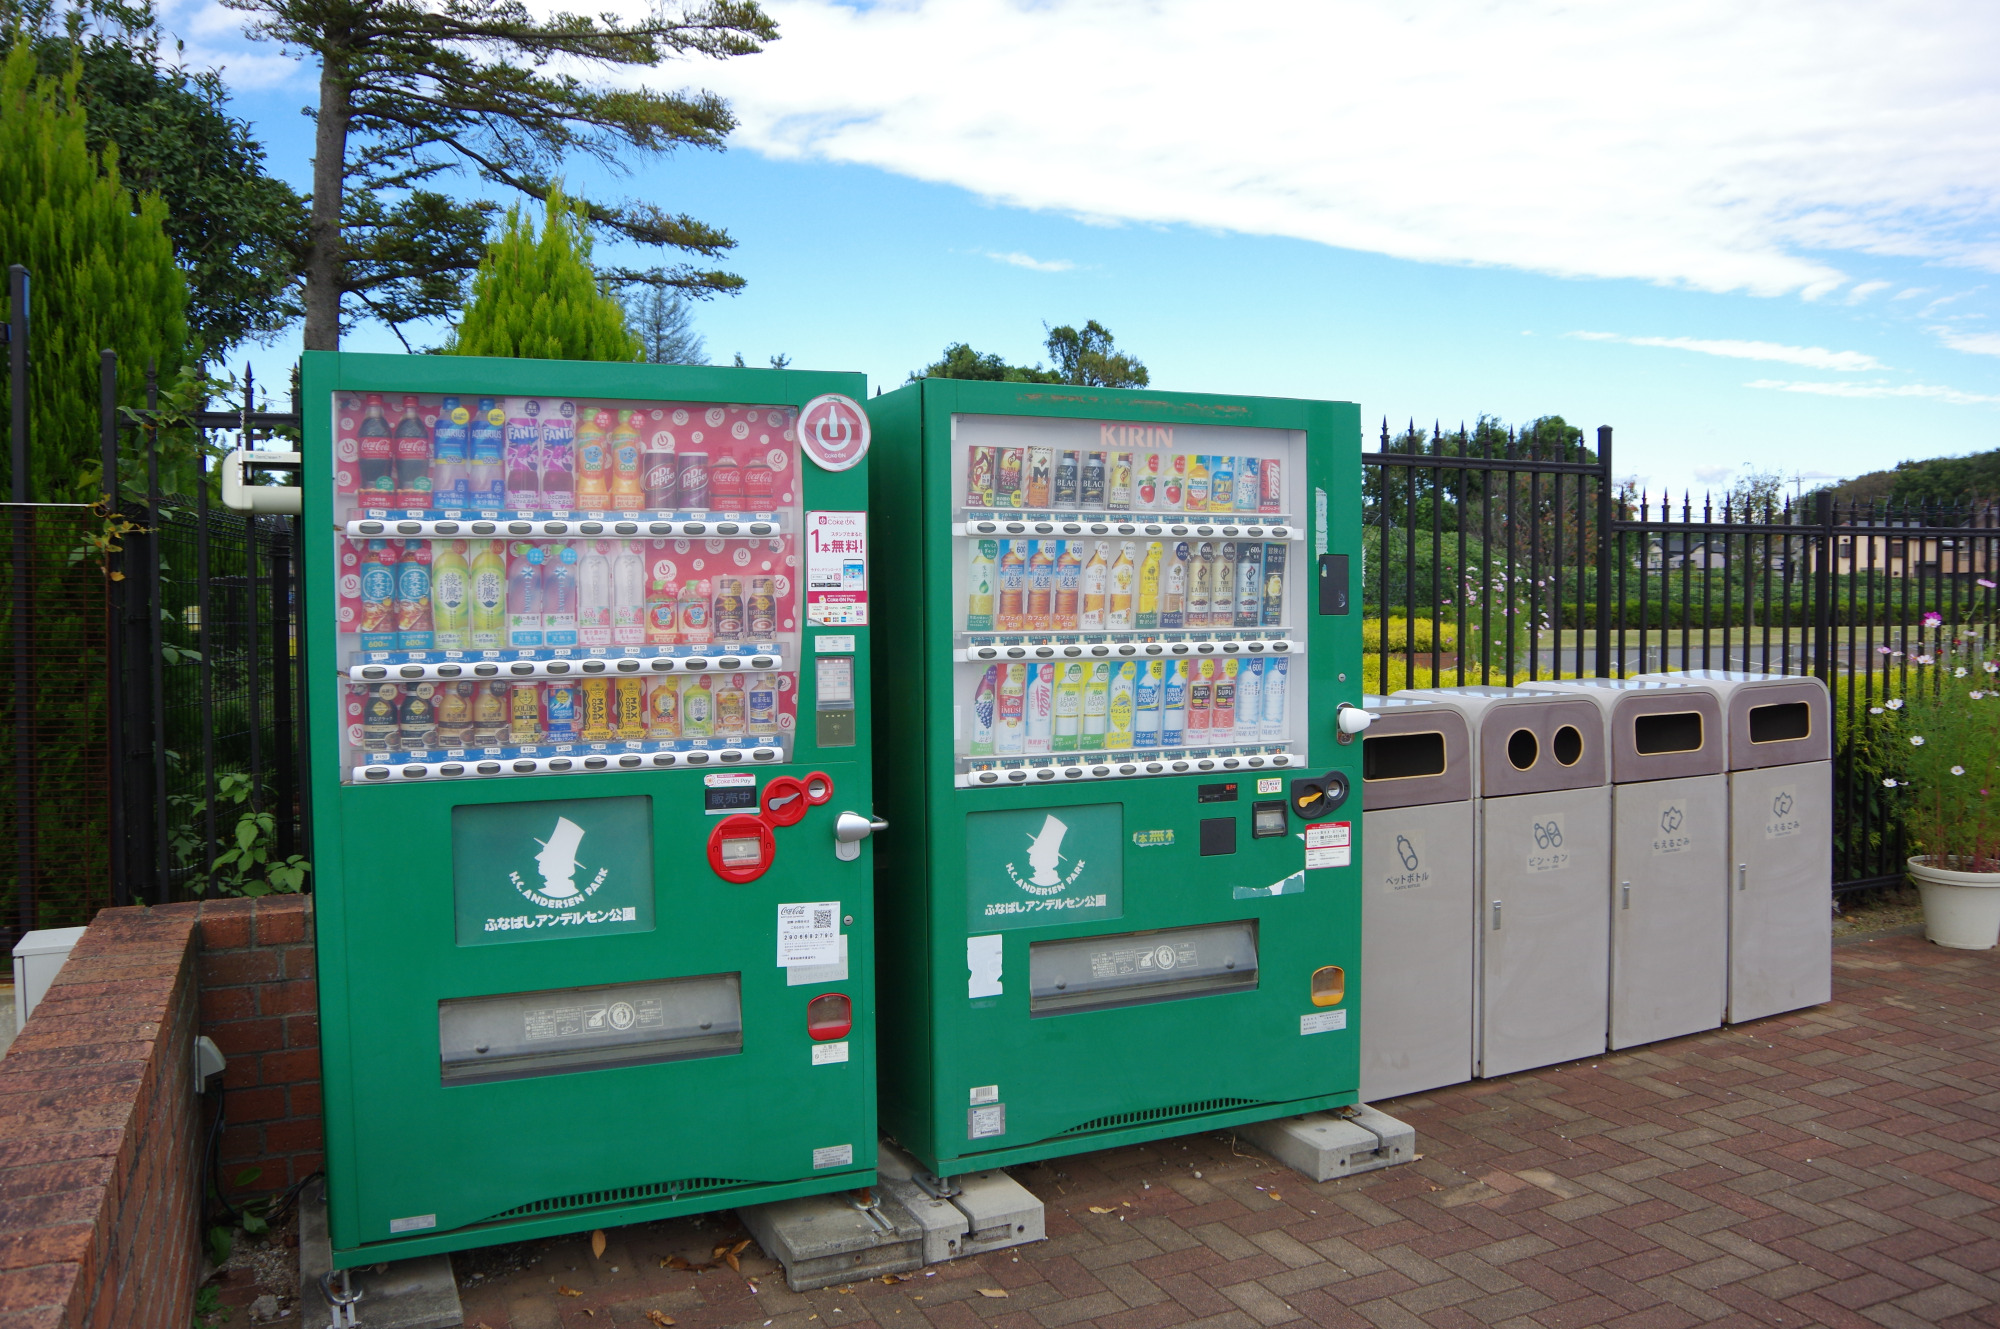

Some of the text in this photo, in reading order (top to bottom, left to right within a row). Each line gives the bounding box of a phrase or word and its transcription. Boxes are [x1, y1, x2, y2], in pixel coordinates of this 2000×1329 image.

[435, 428, 465, 439] AQUARIUS
[472, 429, 502, 439] AQUARIUS
[508, 426, 538, 441] FANTA
[543, 427, 574, 441] FANTA
[1101, 424, 1173, 449] KIRIN
[660, 467, 671, 477] Dr
[692, 467, 703, 478] Dr
[740, 777, 752, 785] Pay
[712, 792, 750, 805] 販売中
[1653, 838, 1690, 849] もえるごみ
[1529, 854, 1568, 866] ビン・カン
[1015, 879, 1066, 896] ANDERSEN
[1065, 859, 1086, 885] PARK
[1385, 872, 1429, 885] ペットボトル
[522, 889, 585, 909] ANDERSEN
[584, 867, 608, 896] PARK
[984, 894, 1107, 916] ふなばしアンデルセン公園
[484, 907, 636, 931] ふなばしアンデルセン公園
